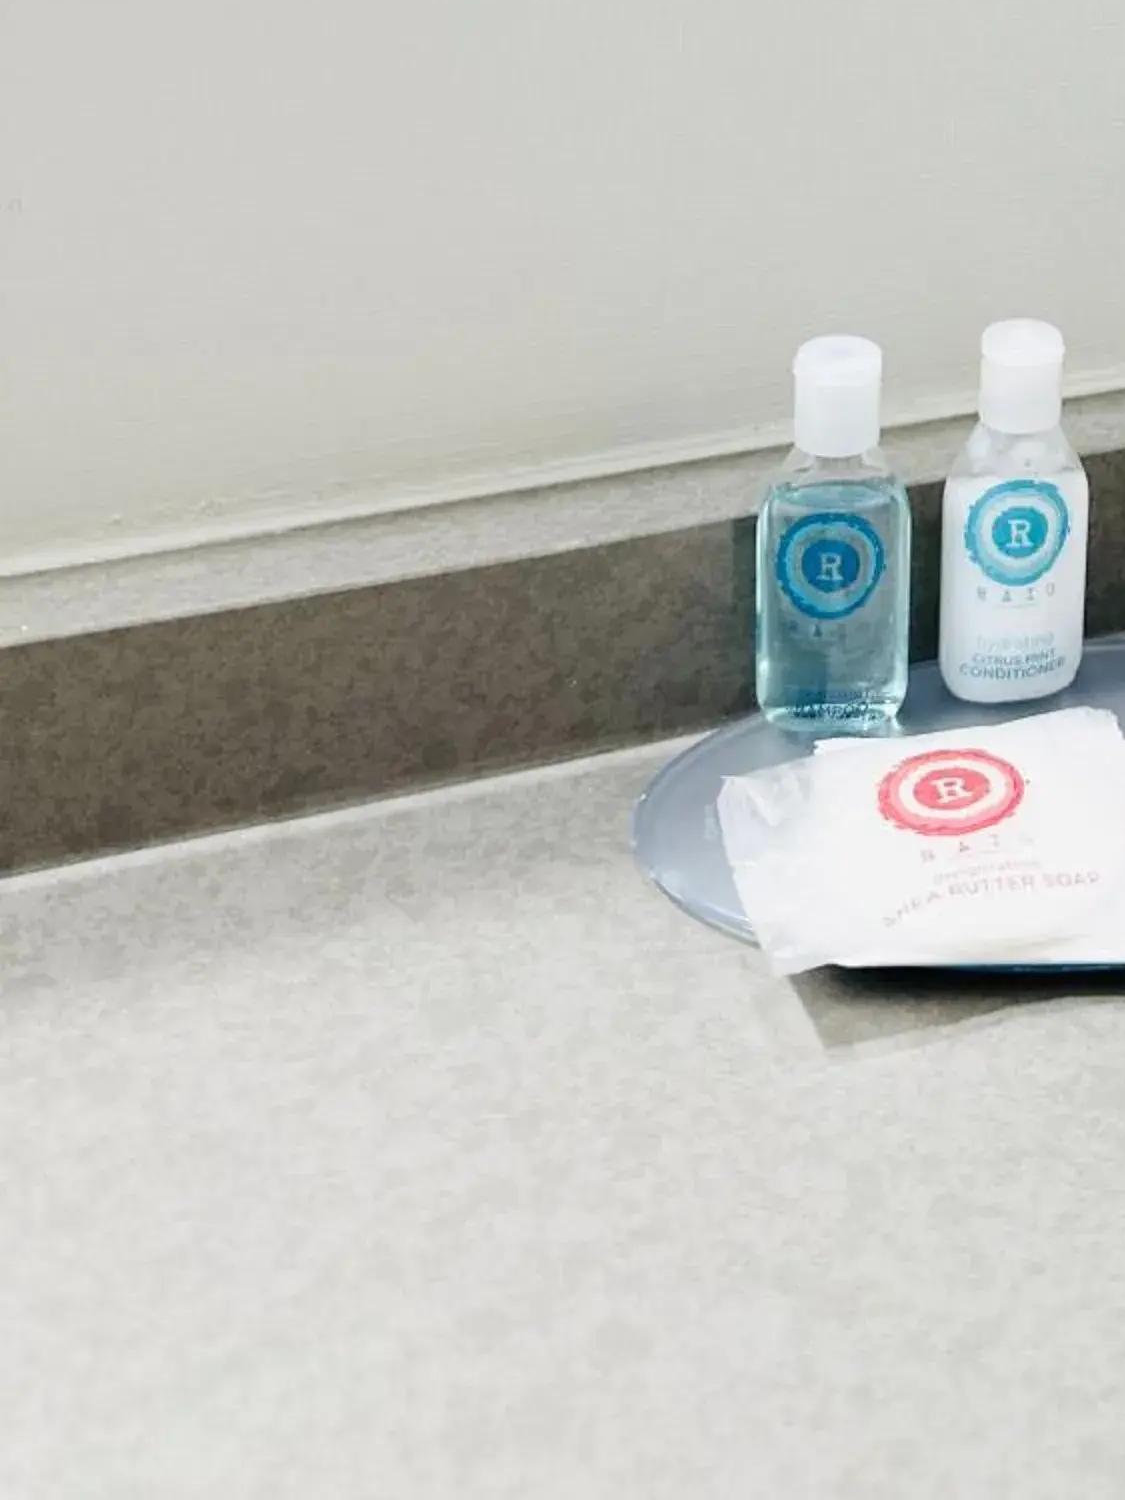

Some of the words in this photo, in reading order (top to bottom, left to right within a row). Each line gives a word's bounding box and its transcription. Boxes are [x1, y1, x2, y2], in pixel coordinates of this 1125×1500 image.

[1008, 519, 1033, 550] R
[816, 552, 844, 581] R
[931, 775, 974, 805] R
[947, 874, 1036, 897] BUTTER
[1041, 869, 1101, 889] SOAP
